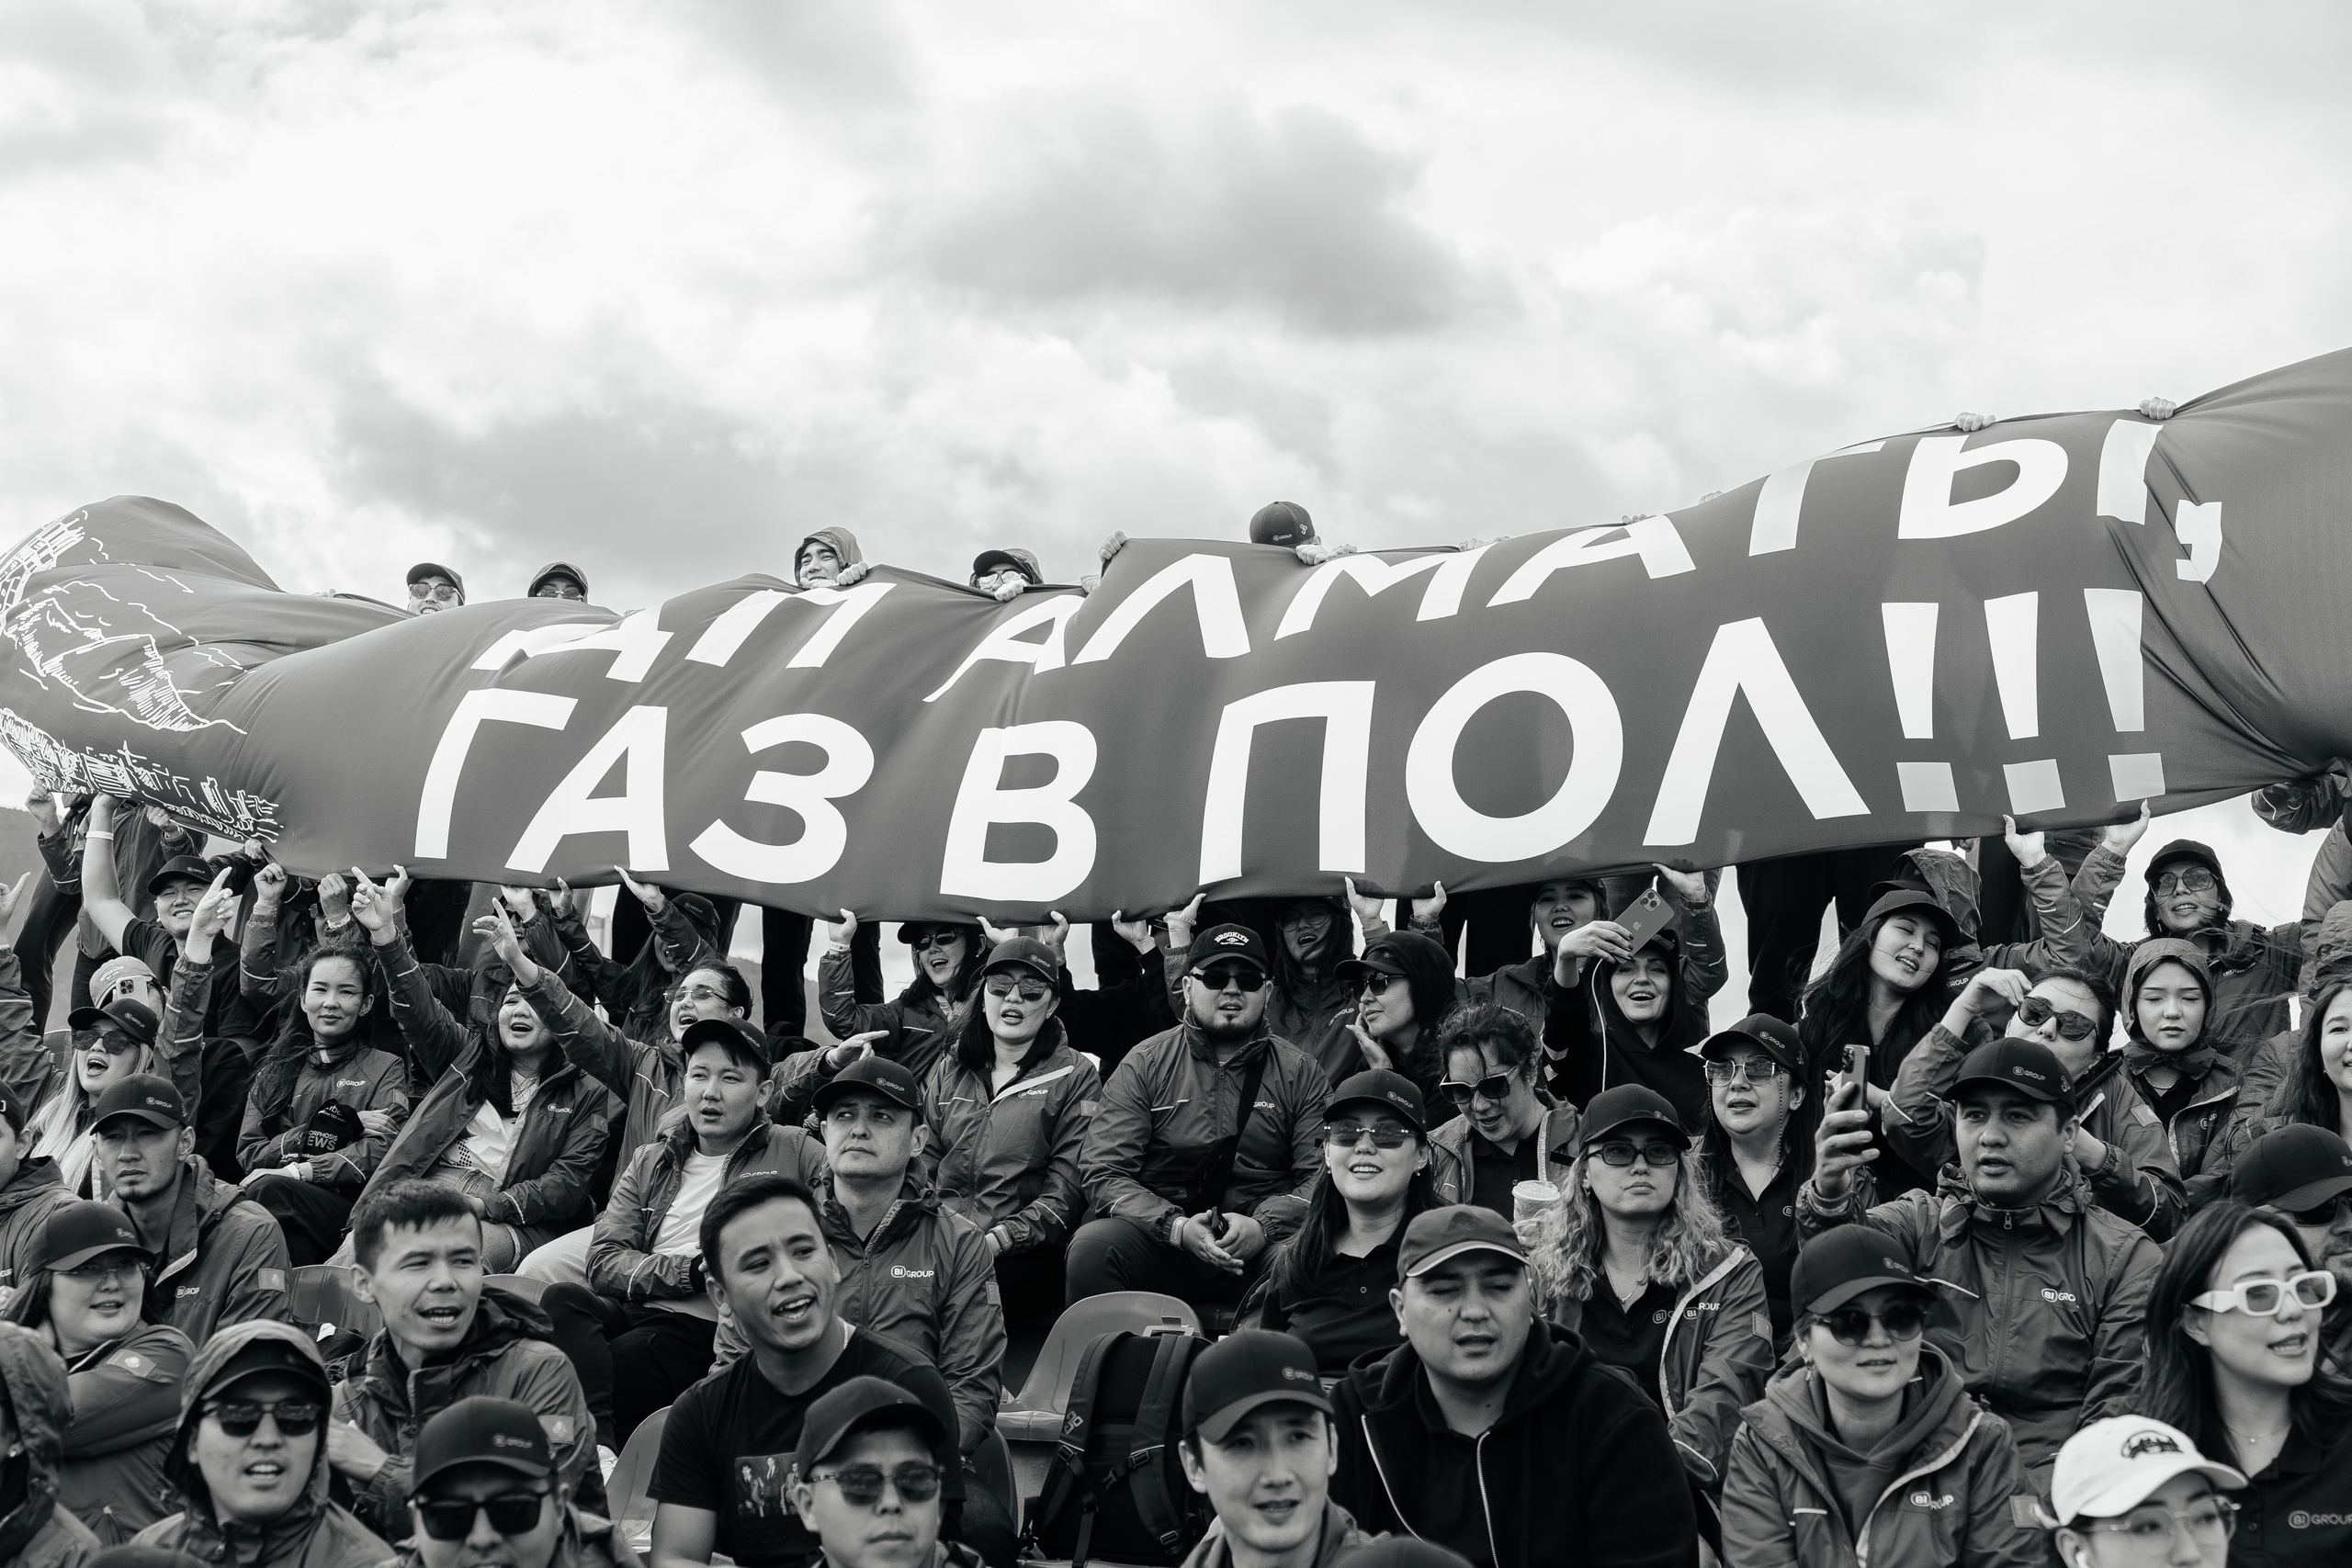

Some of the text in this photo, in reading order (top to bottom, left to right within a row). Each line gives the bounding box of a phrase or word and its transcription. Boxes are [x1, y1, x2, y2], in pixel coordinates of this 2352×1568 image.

[414, 589, 2165, 901] ГАЗ В ПОЛ!!!
[1214, 932, 1250, 943] BROOKLYN
[1769, 1036, 1785, 1048] GROUP
[2024, 1070, 2046, 1080] GROUP
[886, 1082, 905, 1091] GROUP
[1397, 1096, 1414, 1108] GROUP
[306, 1139, 336, 1151] EWS
[893, 1267, 905, 1276] BI
[2043, 1290, 2076, 1302] BI GRO
[1698, 1302, 1720, 1311] ROUP
[1912, 1492, 1954, 1510] BI RUP
[2290, 1512, 2307, 1527] BI
